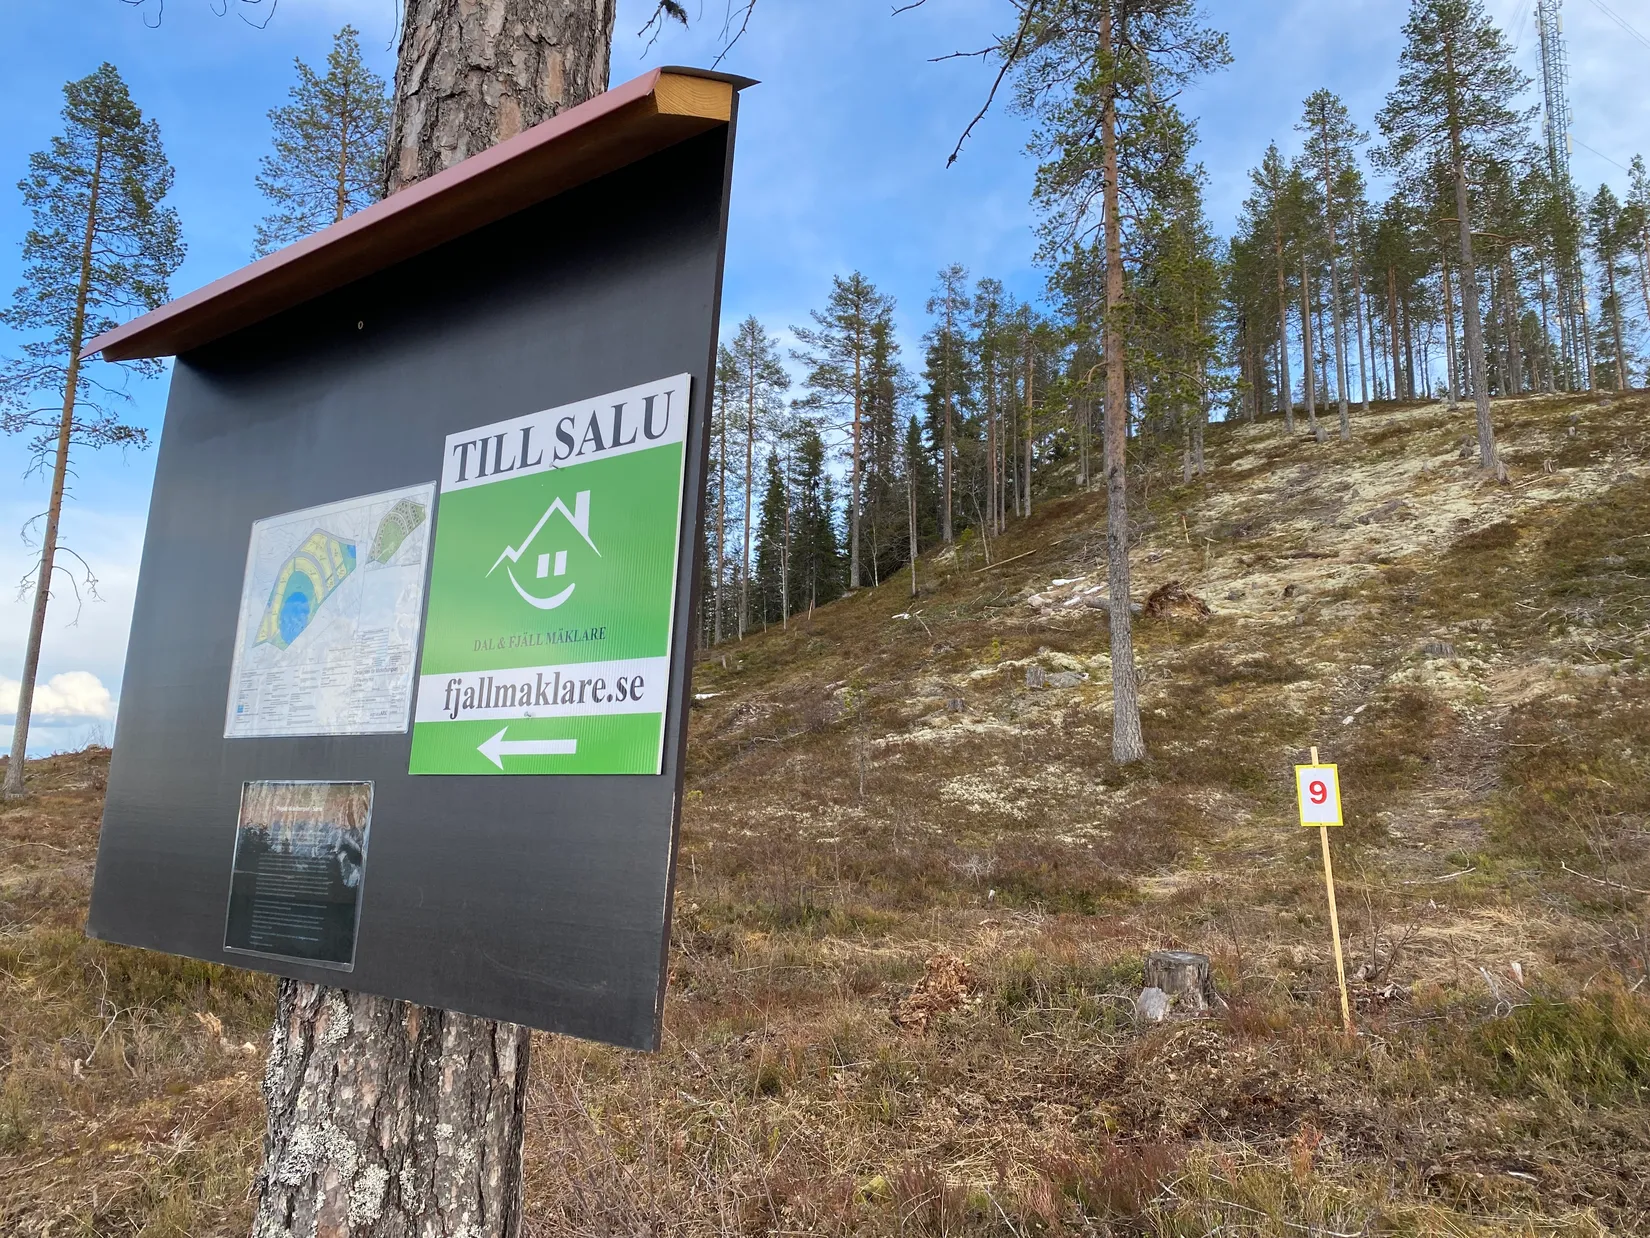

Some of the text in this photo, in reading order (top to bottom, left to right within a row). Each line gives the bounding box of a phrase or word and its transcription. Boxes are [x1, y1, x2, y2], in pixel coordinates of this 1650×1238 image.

[453, 390, 675, 483] TILL SALU
[473, 638, 495, 652] DAL
[497, 636, 506, 650] &
[443, 671, 645, 720] fjallmaklare.se
[1309, 780, 1328, 805] 9
